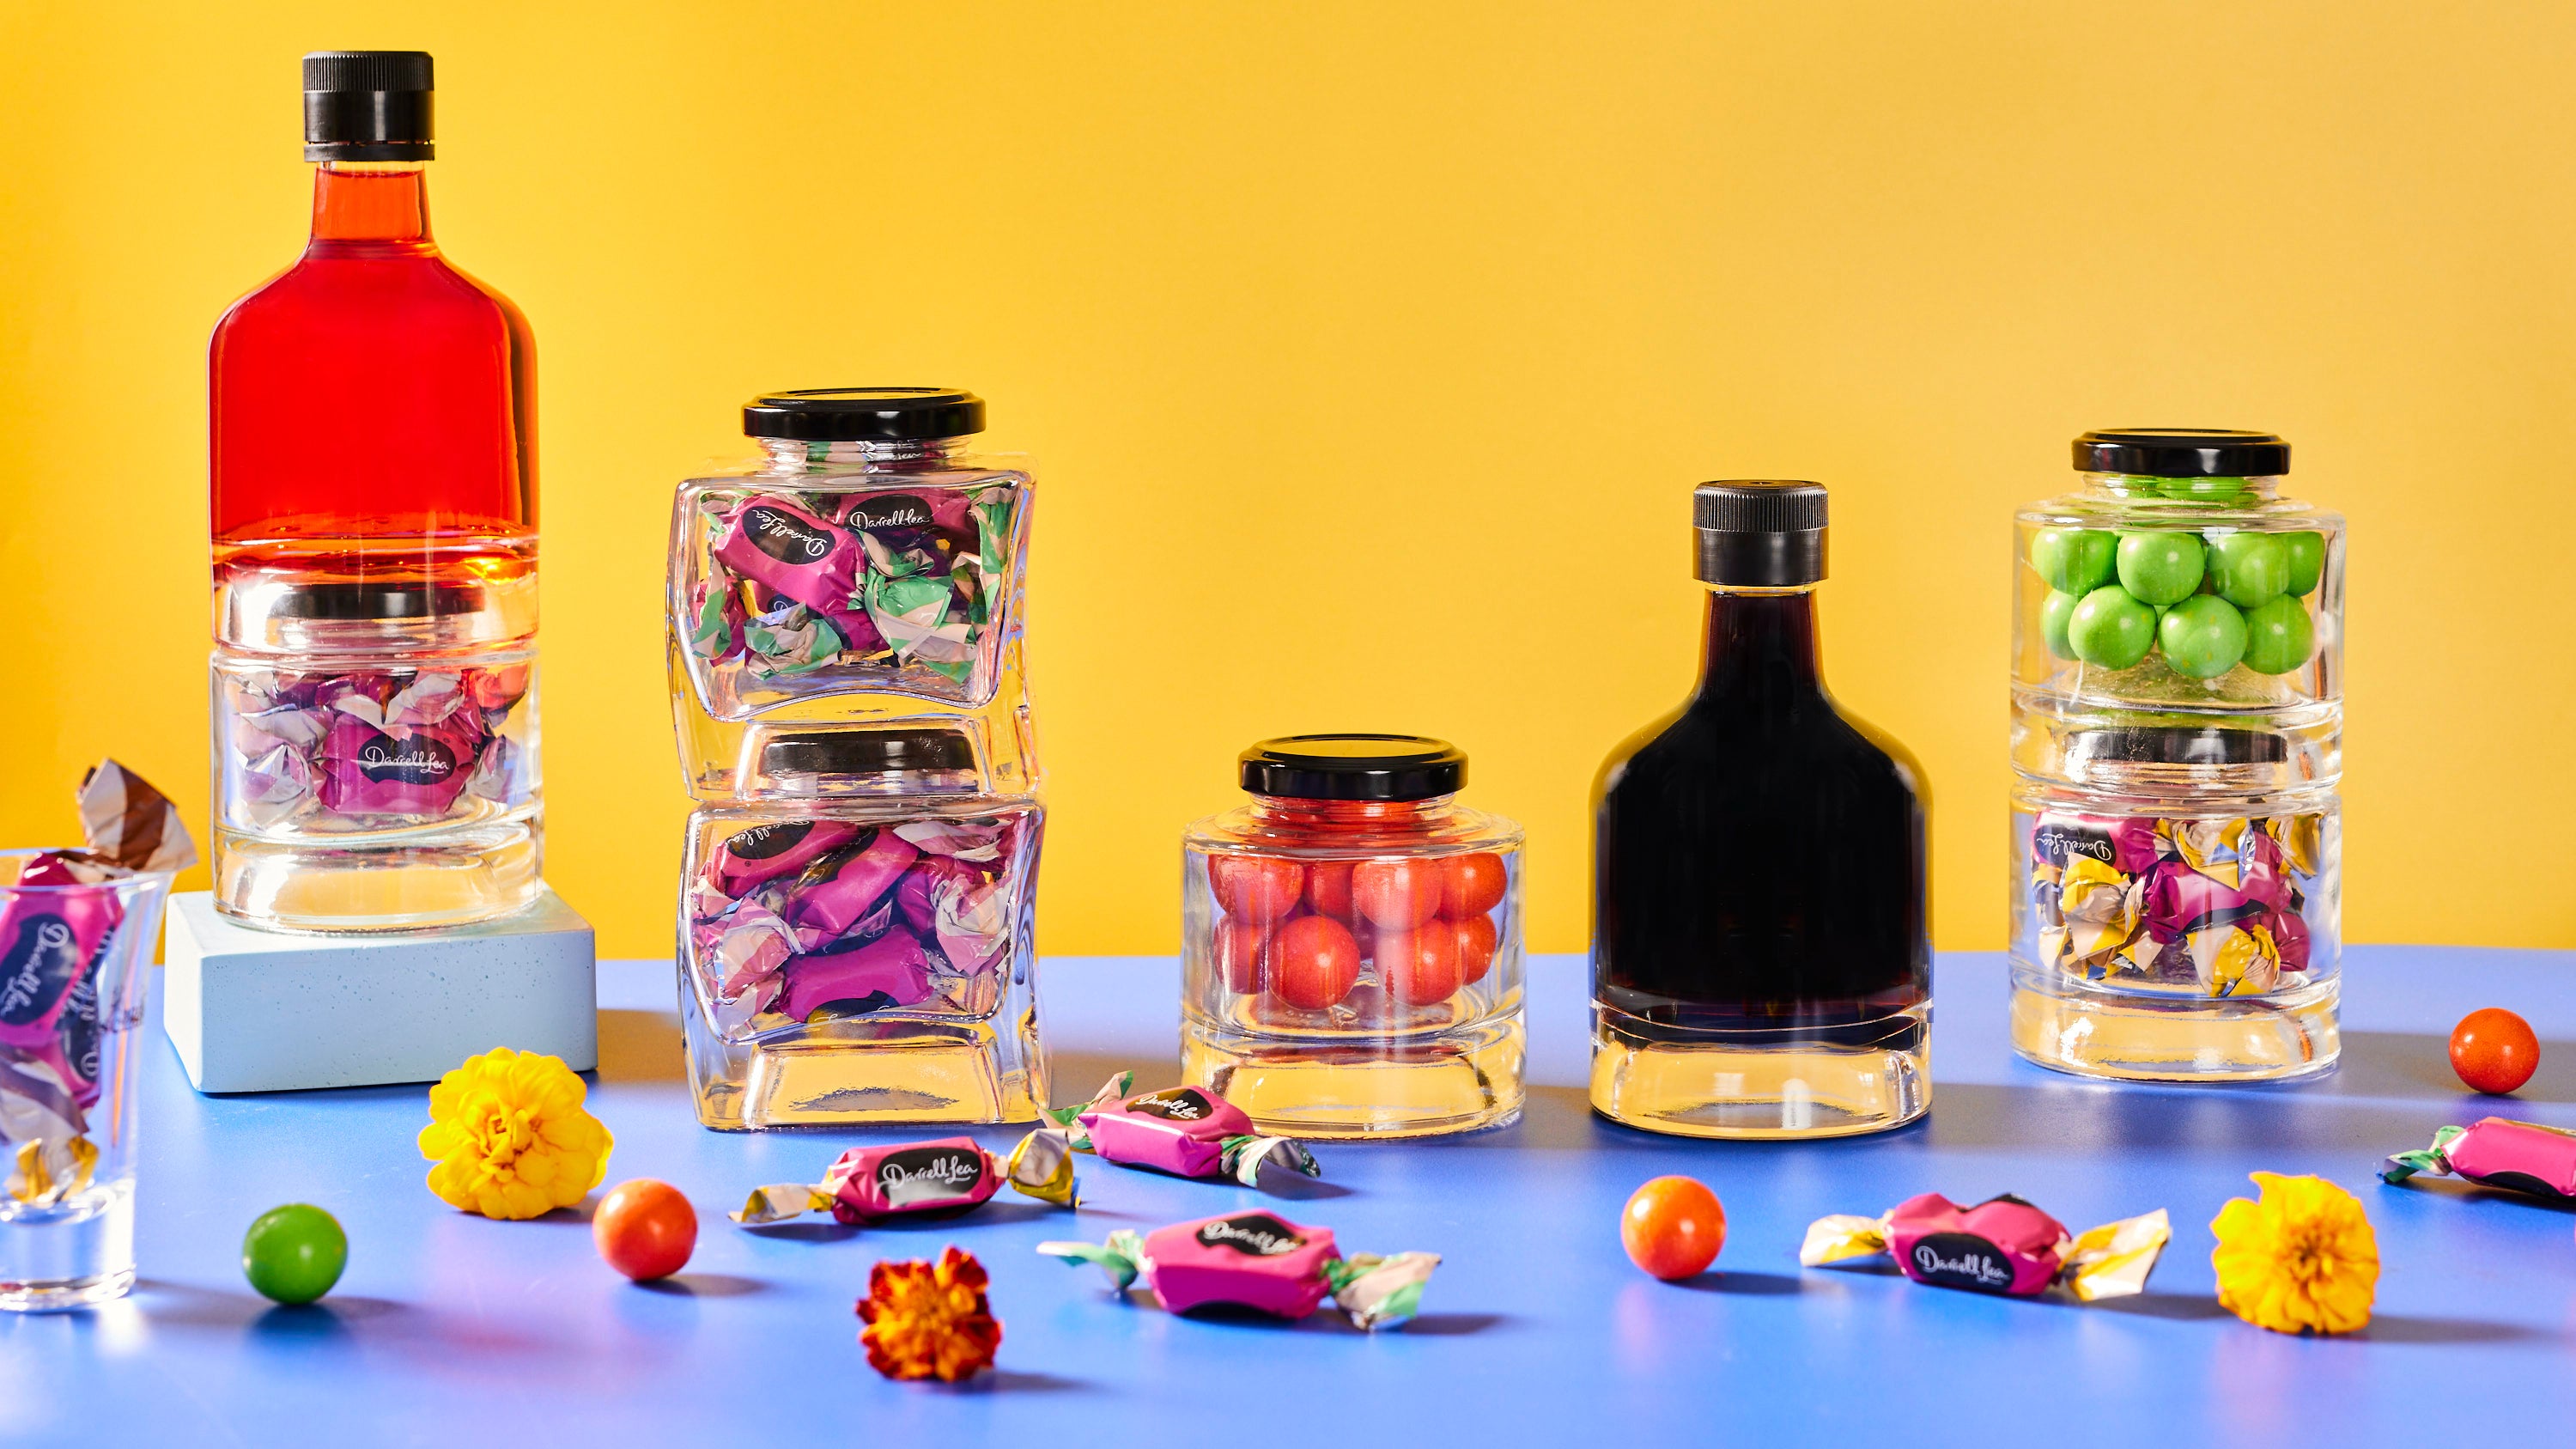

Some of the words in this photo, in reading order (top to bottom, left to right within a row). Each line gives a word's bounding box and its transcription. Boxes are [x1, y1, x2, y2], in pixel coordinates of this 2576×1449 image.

[769, 522, 828, 557] Darrell
[364, 746, 426, 768] Darrell
[882, 1163, 949, 1190] Darrell
